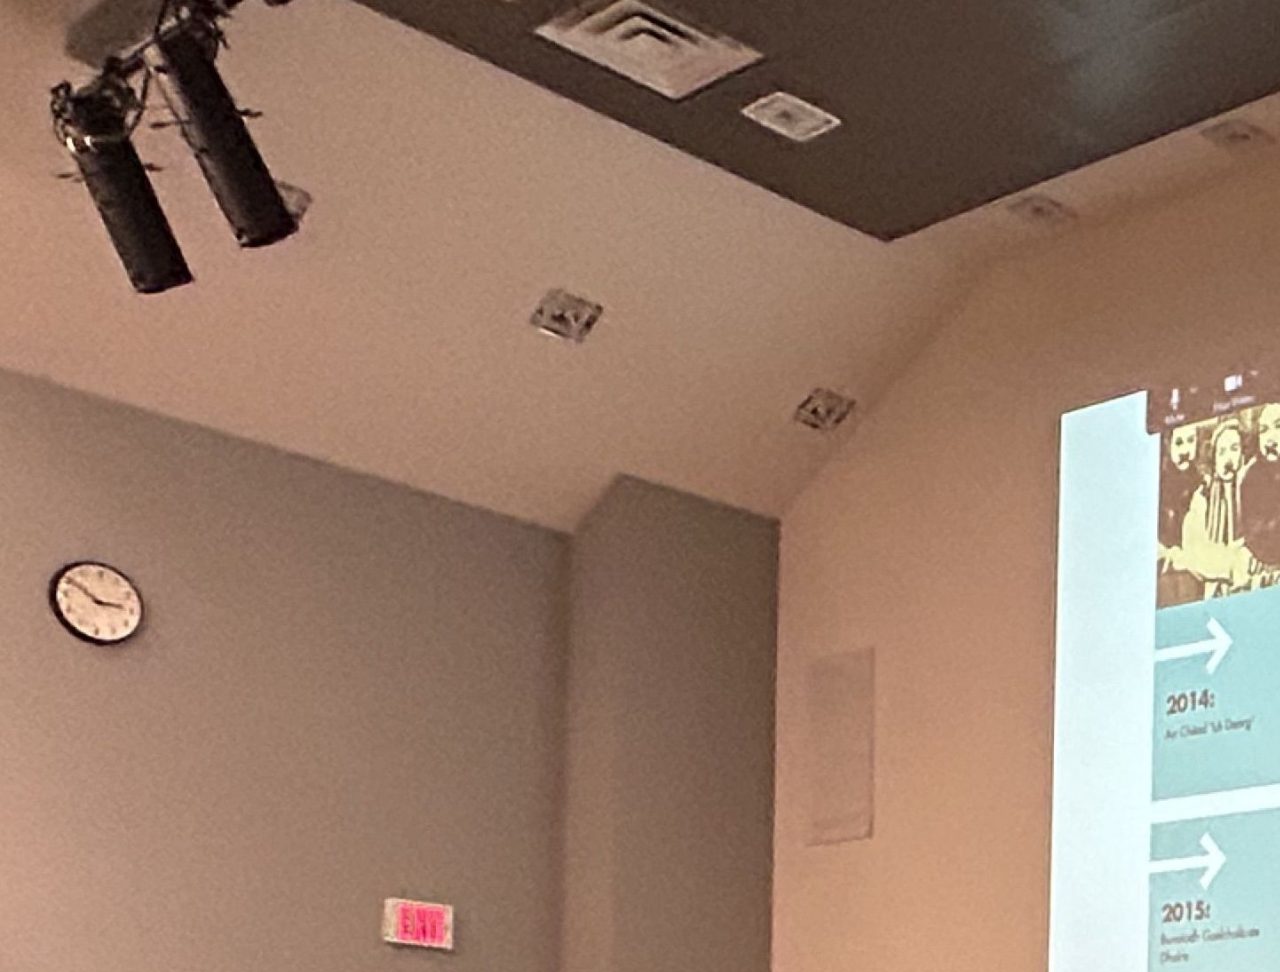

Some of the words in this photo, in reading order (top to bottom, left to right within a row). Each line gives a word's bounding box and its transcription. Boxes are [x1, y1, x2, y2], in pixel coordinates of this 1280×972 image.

[1166, 688, 1215, 717] 2014:
[399, 905, 445, 942] EXIT
[1161, 899, 1211, 924] 2015:
